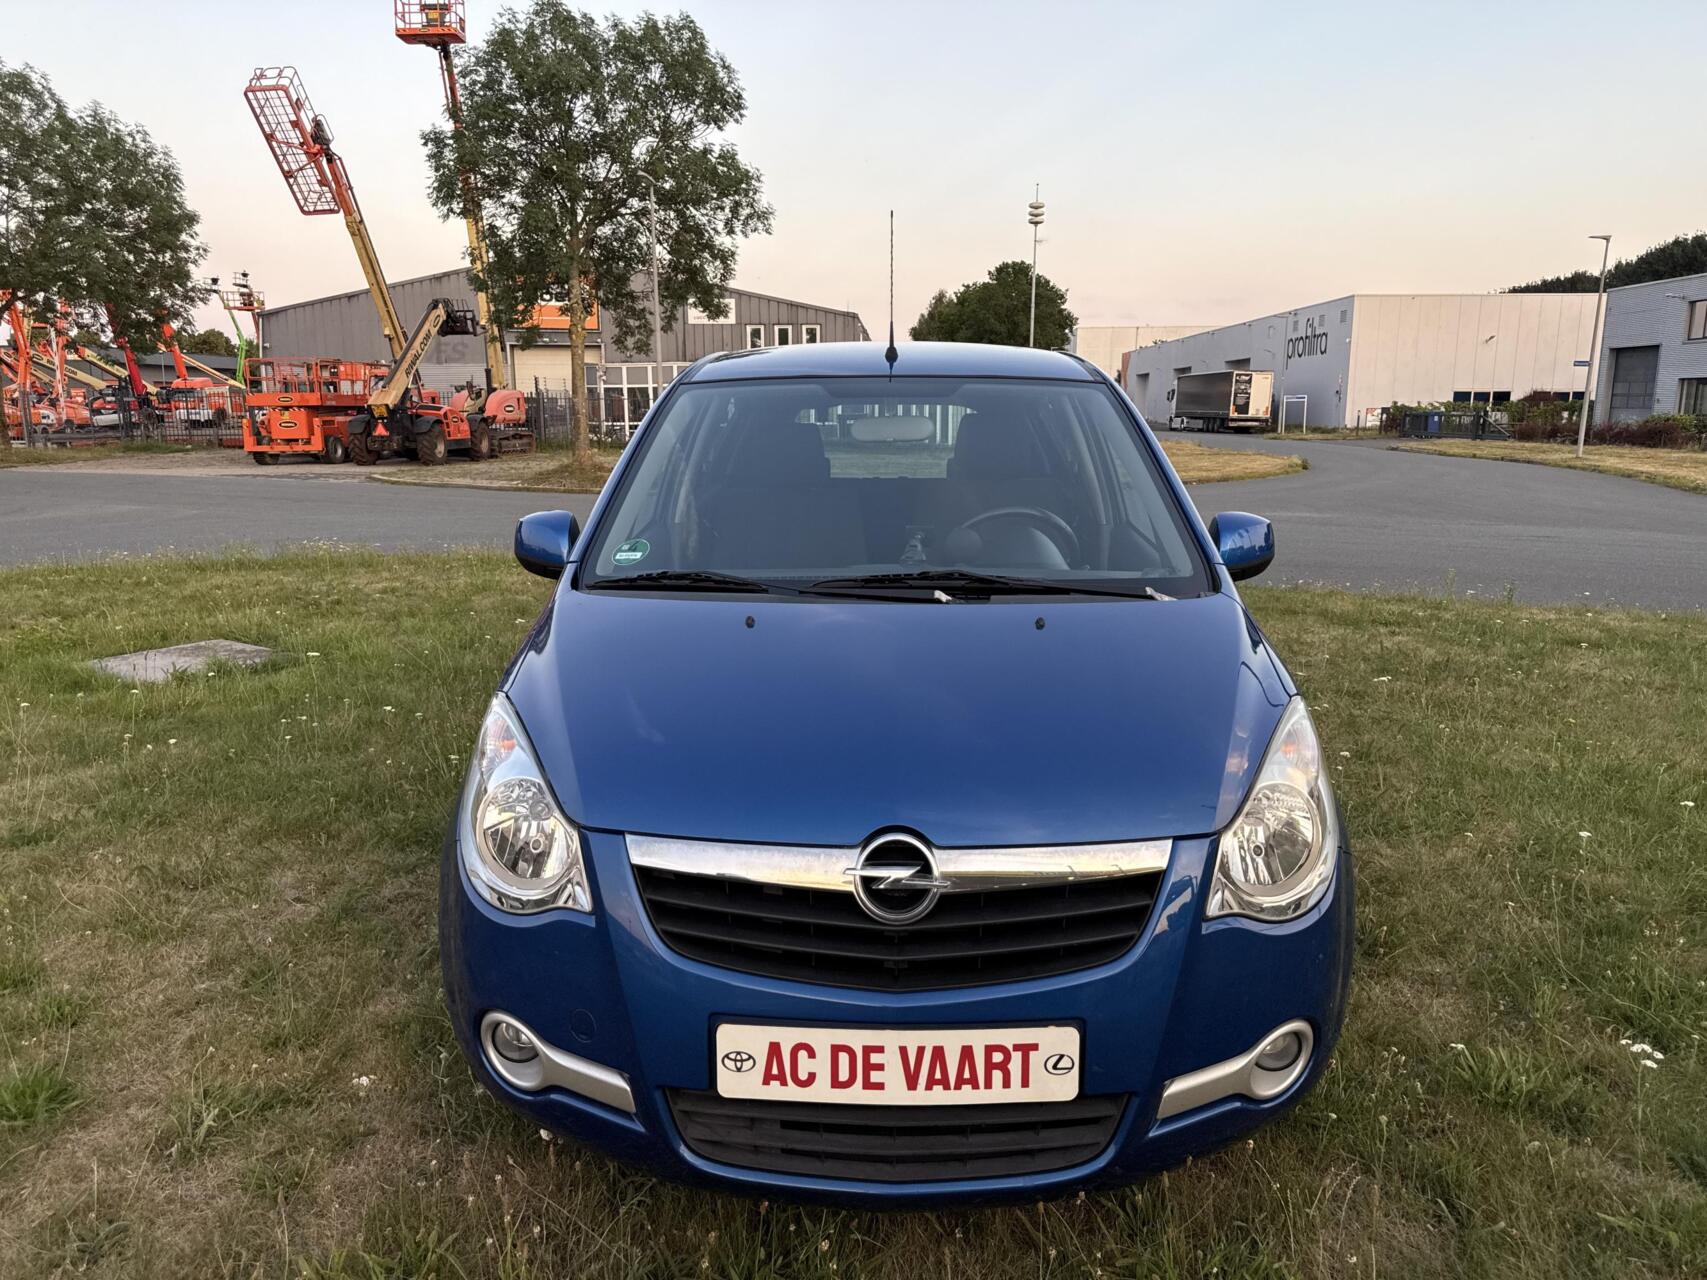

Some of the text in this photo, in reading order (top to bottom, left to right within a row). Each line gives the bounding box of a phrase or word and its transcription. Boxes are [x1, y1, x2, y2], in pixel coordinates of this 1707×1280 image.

[1285, 317, 1328, 371] profiltra
[761, 1040, 1040, 1092] AC DE VAART
